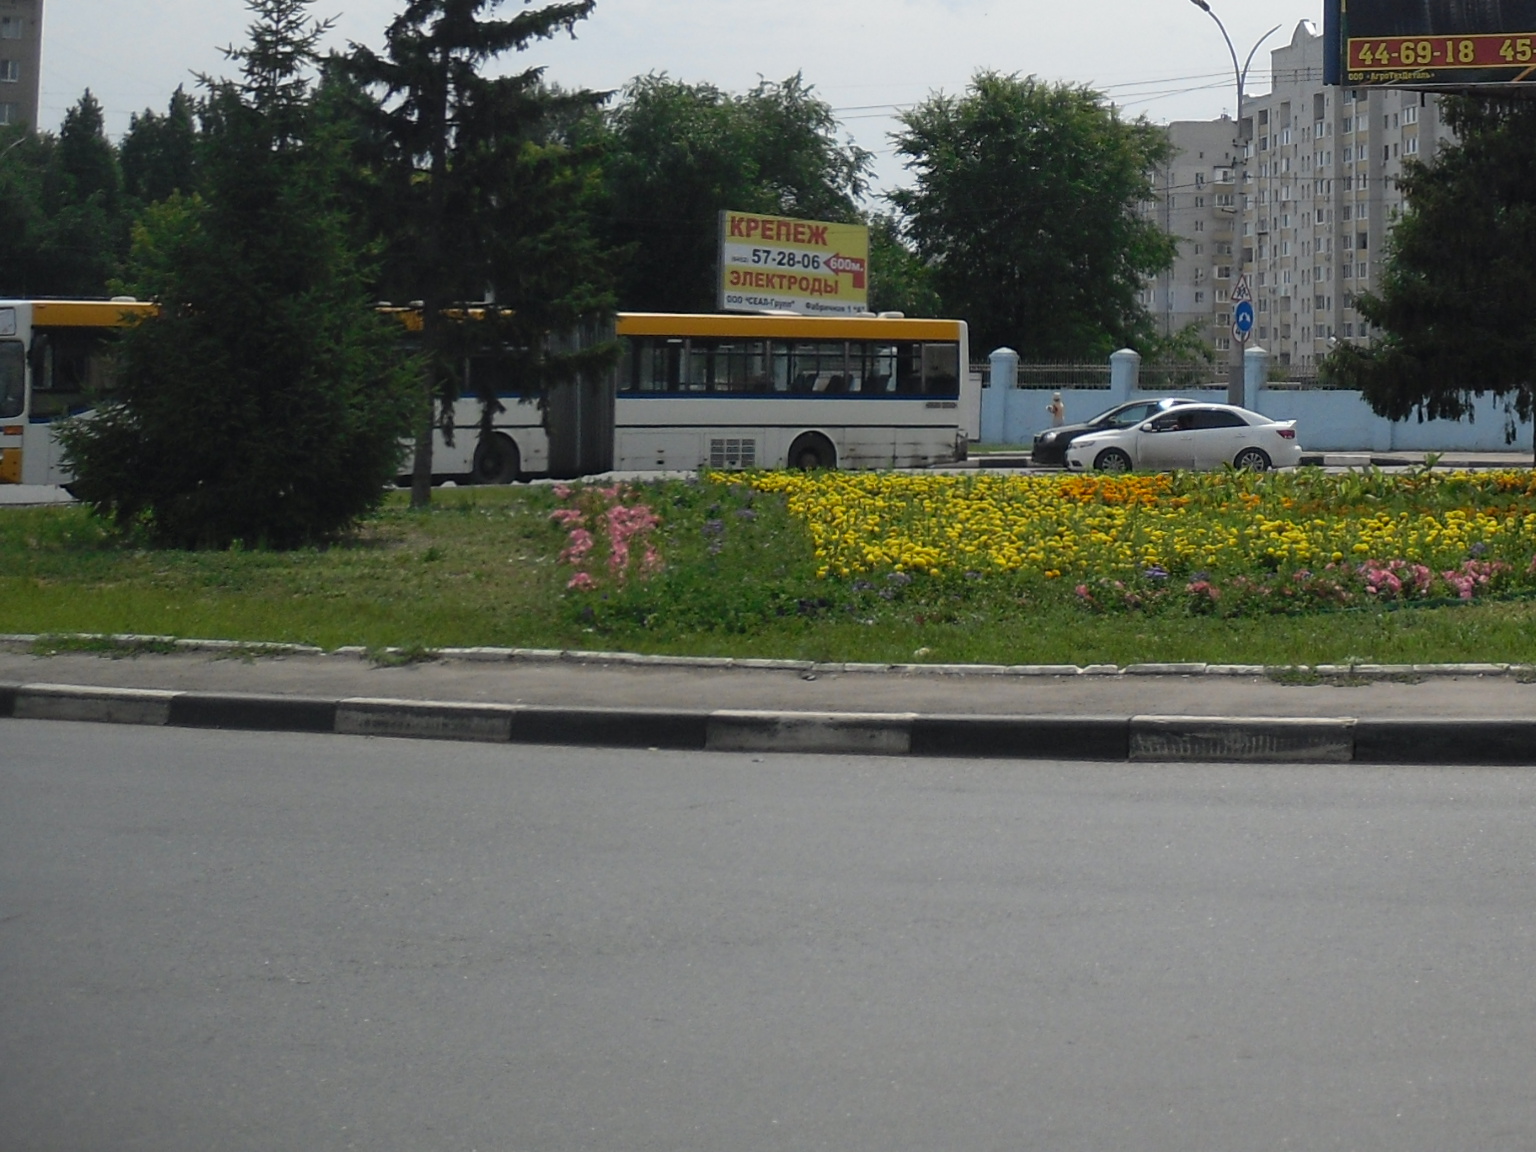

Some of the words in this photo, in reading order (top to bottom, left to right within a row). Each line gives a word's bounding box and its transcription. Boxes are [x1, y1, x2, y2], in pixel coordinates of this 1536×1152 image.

[1358, 41, 1475, 65] 44-69-18
[730, 216, 828, 246] КРЕПЕЖ
[752, 249, 820, 270] 57-28-06
[730, 270, 839, 296] ЭЛЕКТРОДЫ
[726, 295, 743, 304] ООО
